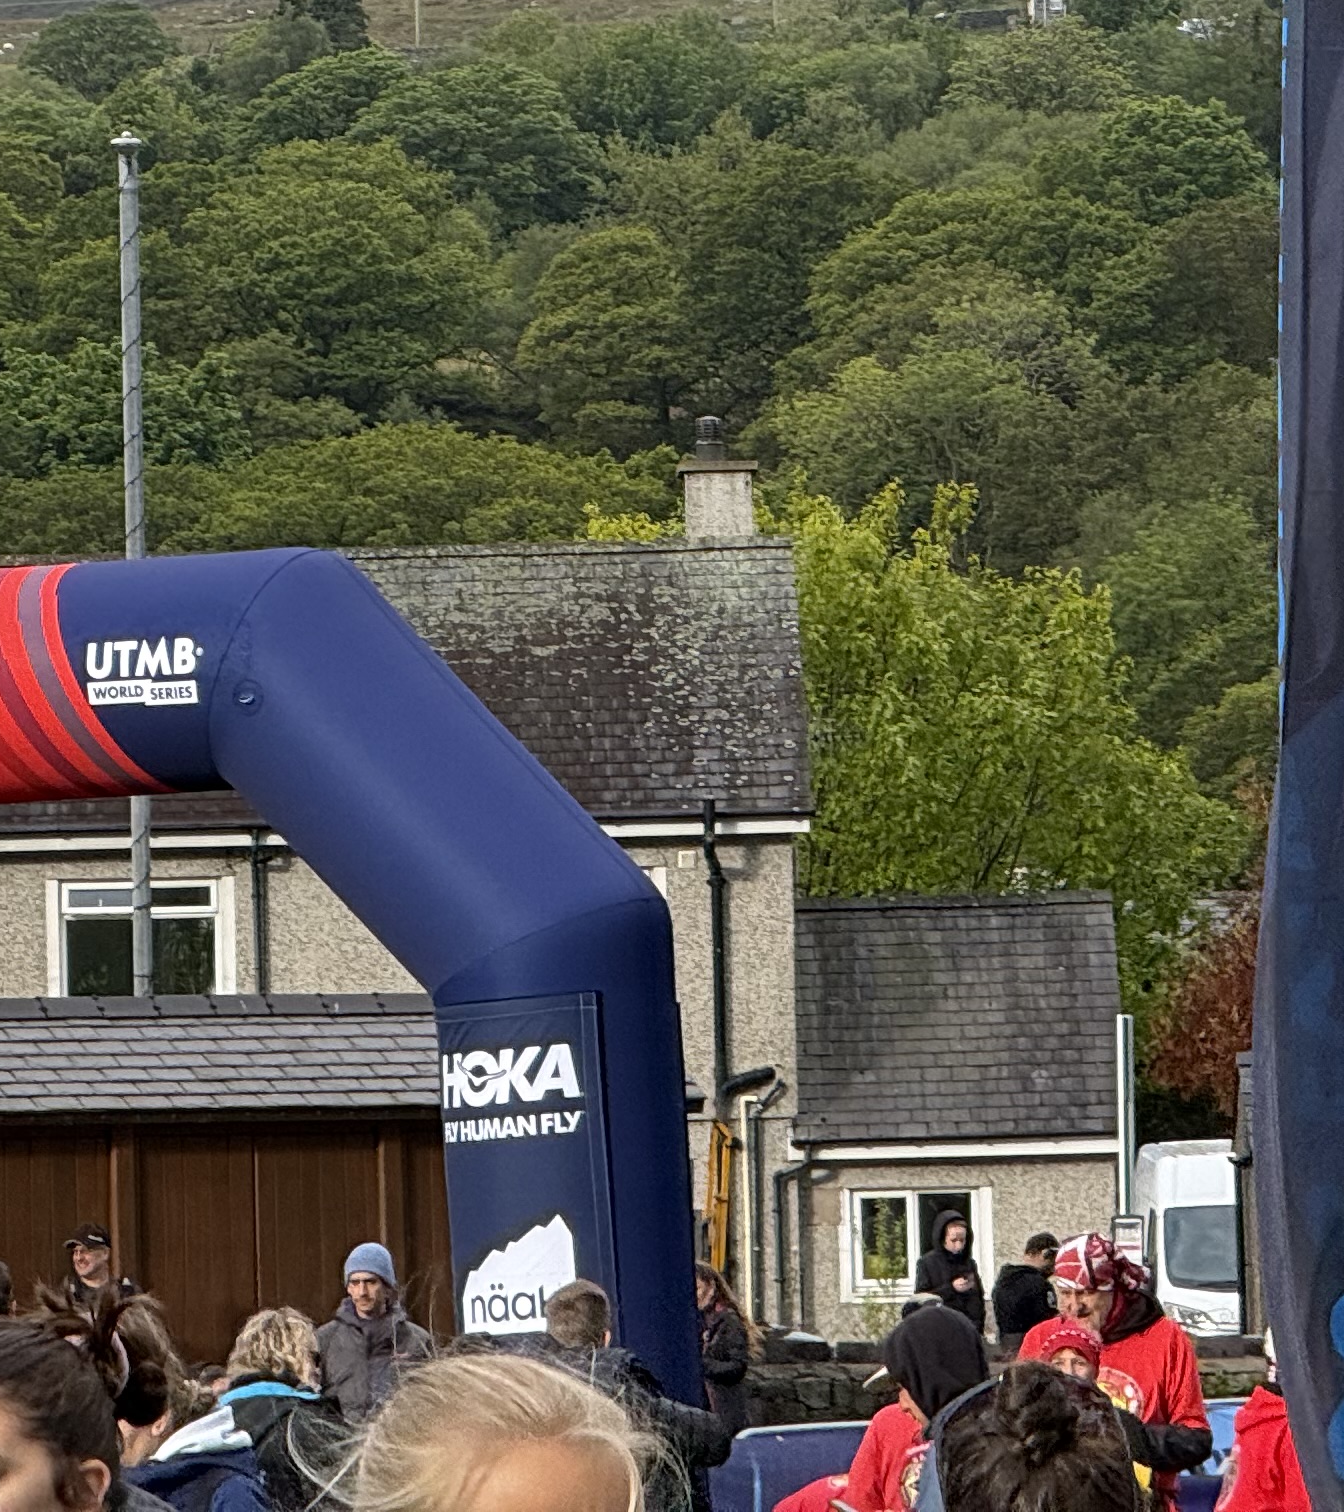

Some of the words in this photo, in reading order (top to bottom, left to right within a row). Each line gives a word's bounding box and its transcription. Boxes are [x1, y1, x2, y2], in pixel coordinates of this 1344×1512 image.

[86, 636, 197, 679] UTMB
[93, 685, 144, 700] WORLD
[150, 685, 193, 701] SERIES
[443, 1043, 582, 1109] HOKA
[460, 1114, 538, 1142] HUMAN
[541, 1110, 582, 1134] FLY
